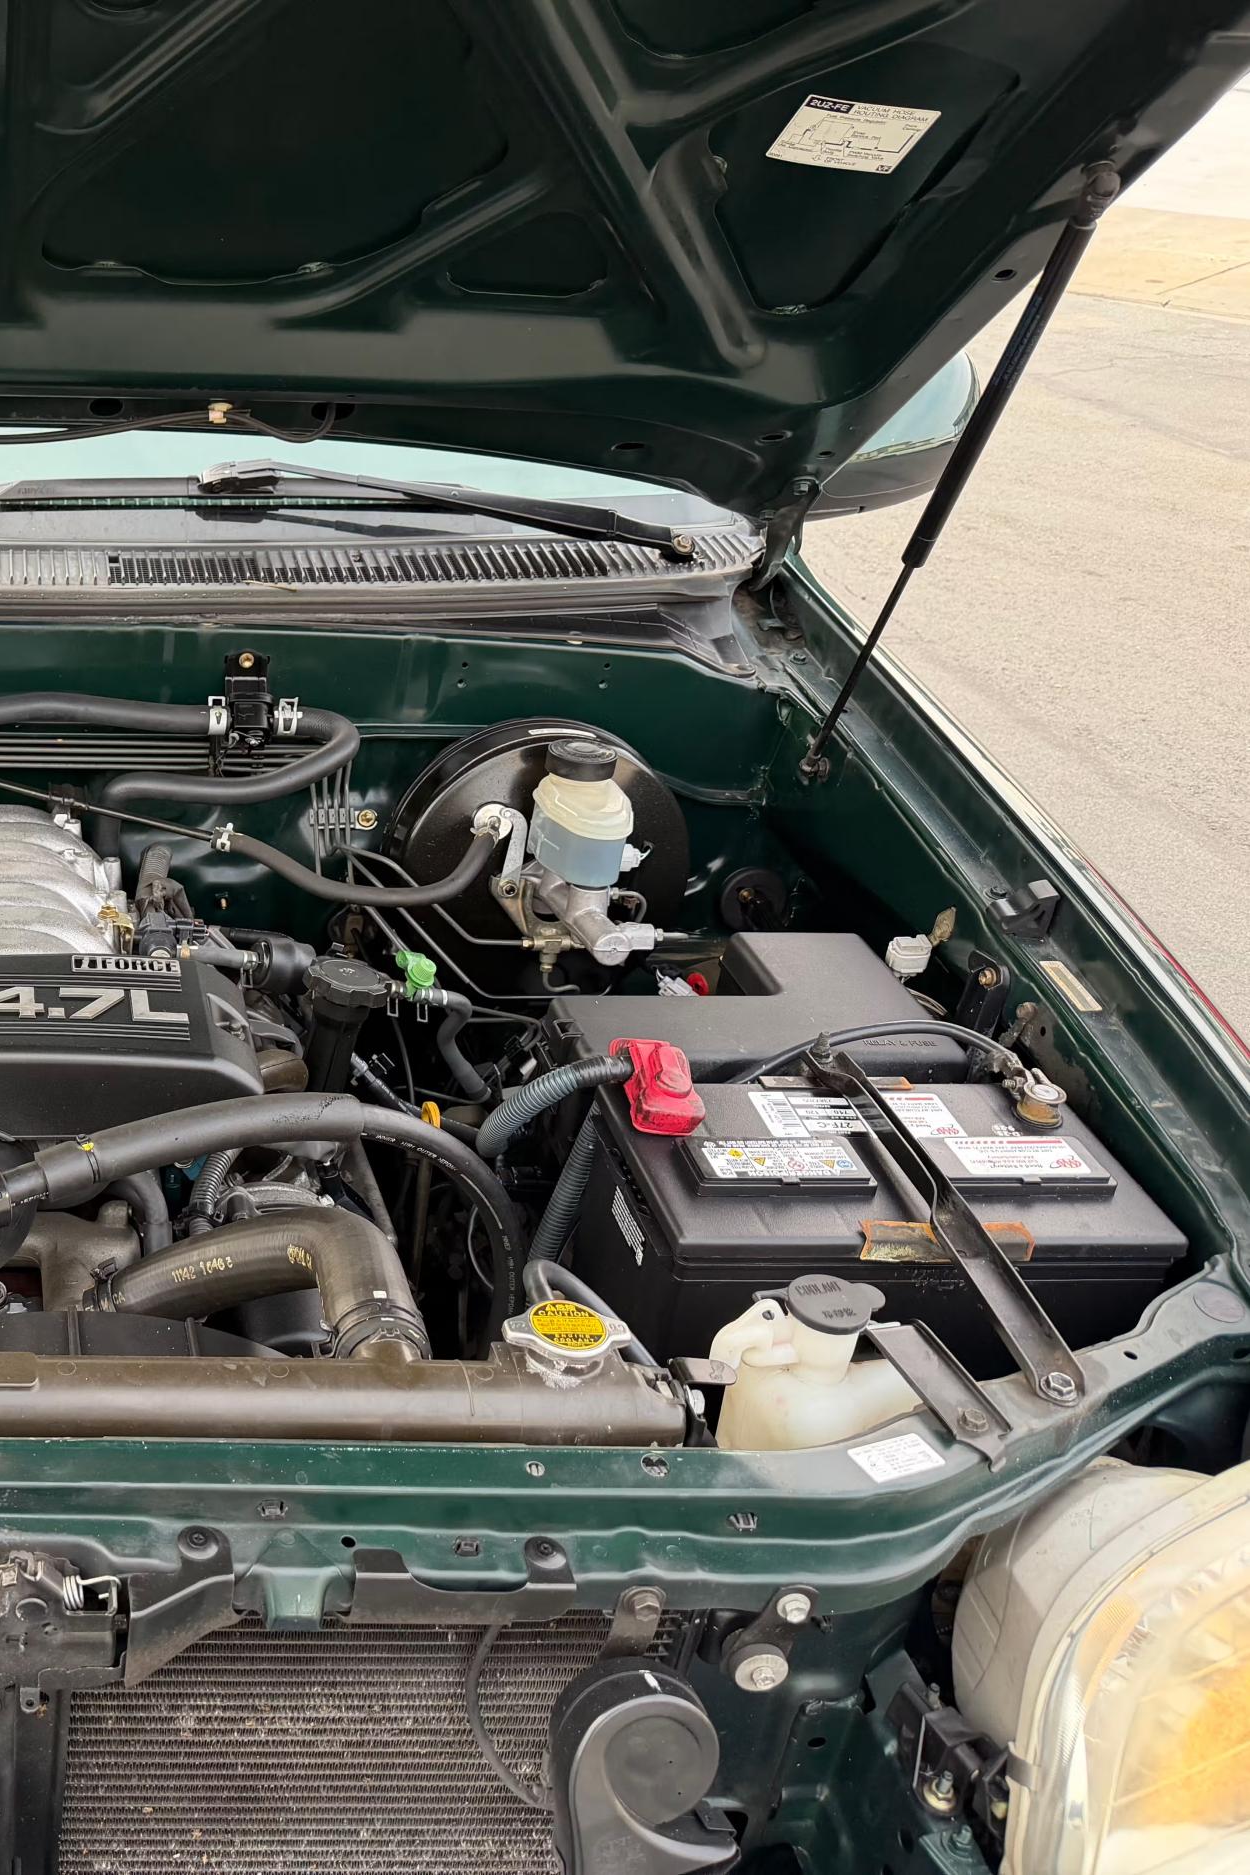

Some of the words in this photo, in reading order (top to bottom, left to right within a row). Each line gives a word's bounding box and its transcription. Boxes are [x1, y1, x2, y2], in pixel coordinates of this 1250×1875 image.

[809, 99, 850, 112] 2UZ-FE
[857, 105, 891, 113] VACUUM
[853, 110, 889, 118] ROUTING
[891, 114, 928, 122] DIAGRAM
[862, 1039, 896, 1047] RELAY
[910, 1039, 939, 1047] FUSE
[416, 1146, 438, 1159] OUTER
[794, 1280, 842, 1297] COOLANT
[538, 1310, 590, 1318] CAUTION
